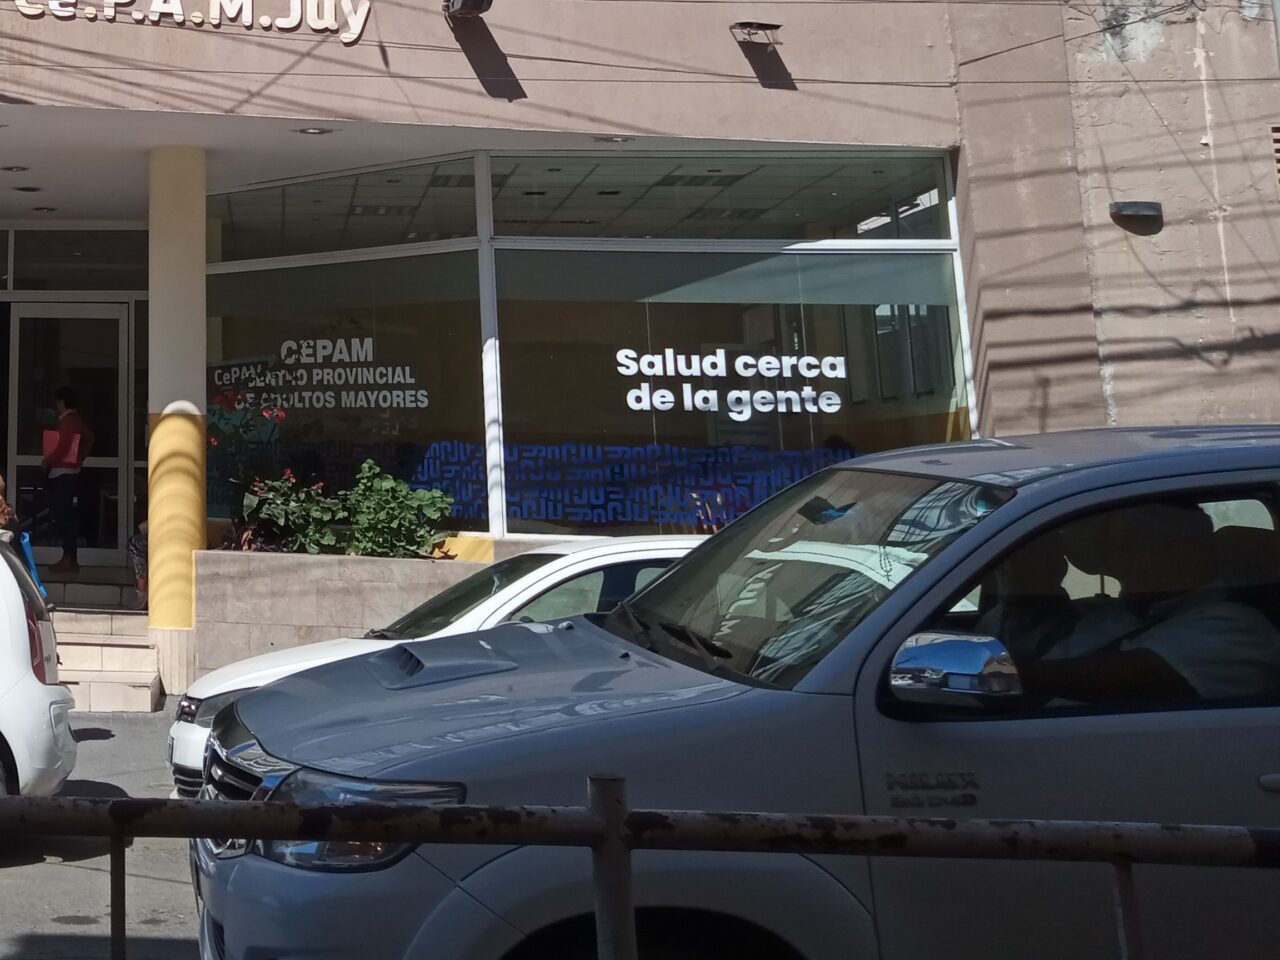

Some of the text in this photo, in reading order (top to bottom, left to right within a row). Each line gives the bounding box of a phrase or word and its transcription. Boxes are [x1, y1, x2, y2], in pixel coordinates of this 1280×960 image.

[280, 338, 373, 364] CEPAM
[616, 348, 847, 379] Salud cerca
[312, 366, 415, 385] PROVINCIAL
[341, 390, 429, 408] MAYORES
[626, 383, 842, 422] de la gente
